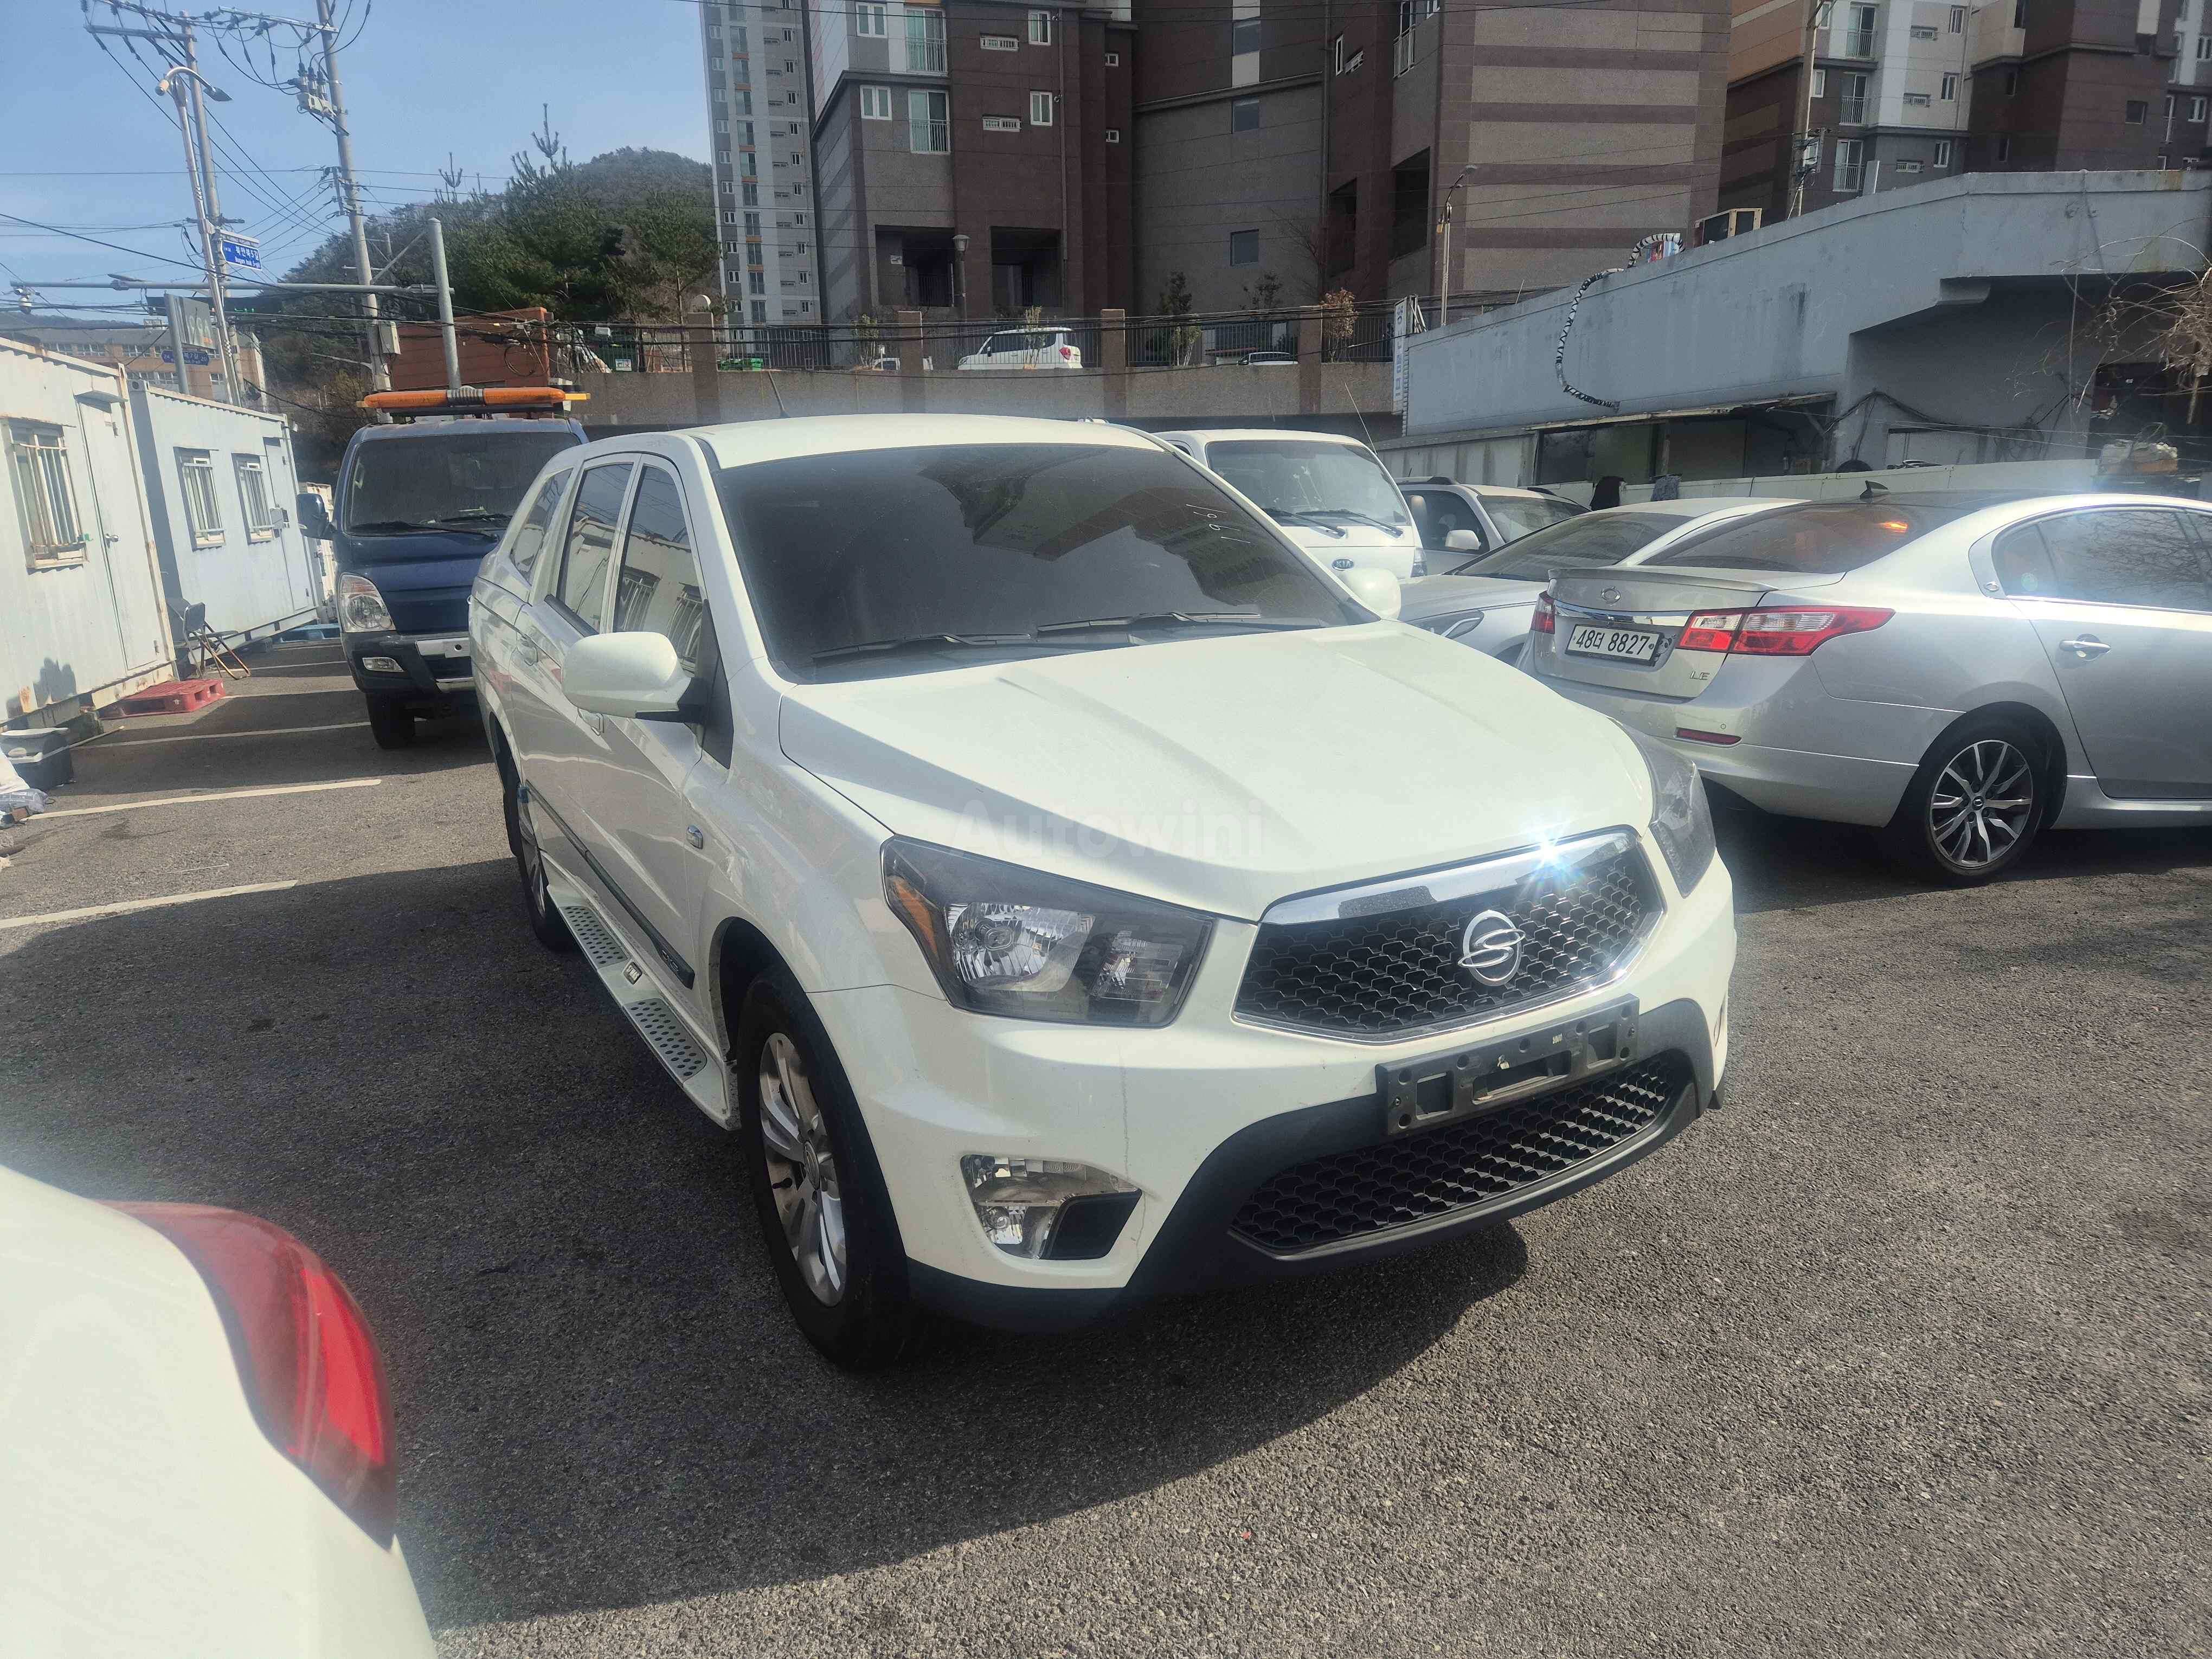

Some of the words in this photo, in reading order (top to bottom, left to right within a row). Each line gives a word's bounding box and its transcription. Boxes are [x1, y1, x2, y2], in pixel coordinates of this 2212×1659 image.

[1576, 629, 1605, 650] 48더
[1607, 632, 1650, 655] 8827
[1689, 671, 1710, 680] LE
